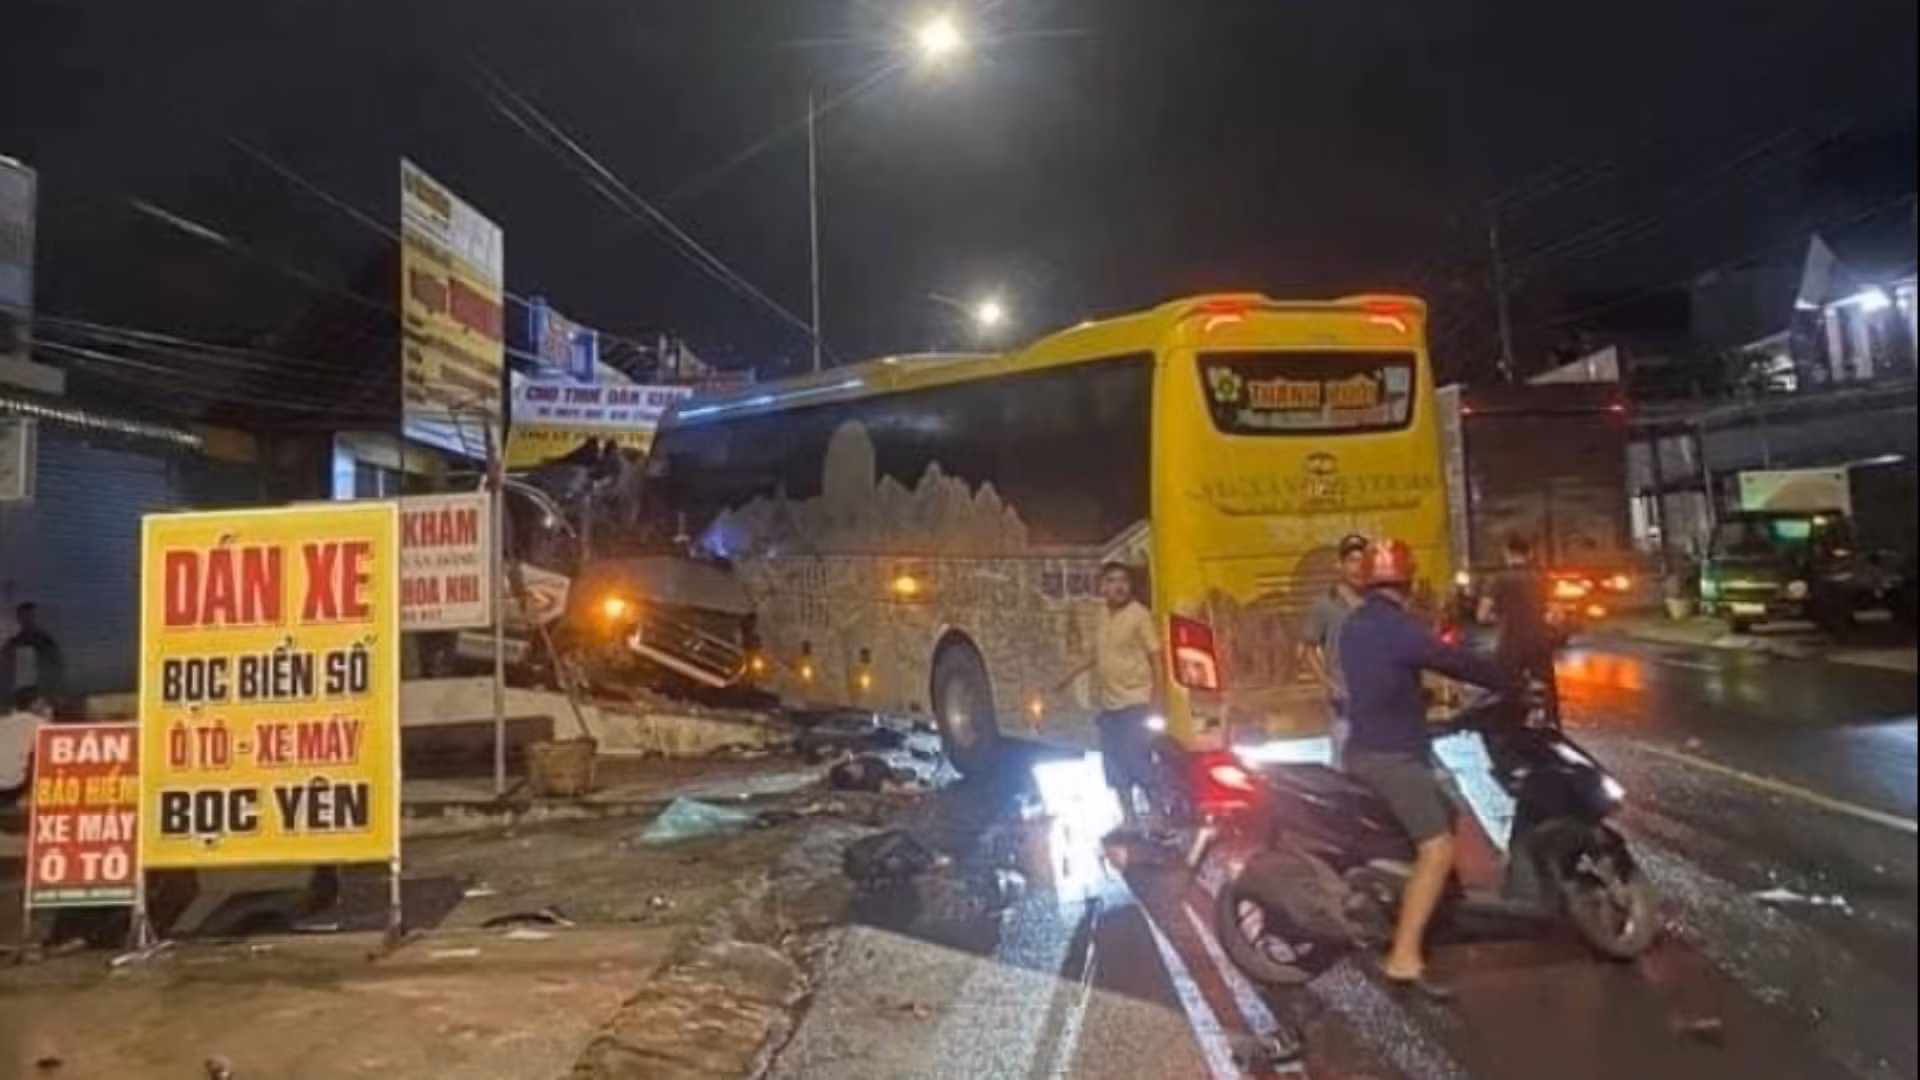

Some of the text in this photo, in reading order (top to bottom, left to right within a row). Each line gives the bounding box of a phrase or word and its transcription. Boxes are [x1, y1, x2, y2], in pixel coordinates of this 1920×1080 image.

[301, 541, 371, 620] XE
[163, 636, 377, 713] BỌC BIỂN SỐ
[51, 730, 130, 765] BÁN
[169, 721, 187, 768] Ô
[197, 720, 229, 768] TÔ
[256, 723, 289, 763] XE
[296, 715, 361, 761] MÁY
[37, 806, 134, 844] XE MÁY
[161, 776, 370, 846] BỌC YÊN
[40, 847, 128, 883] Ô TÔ
